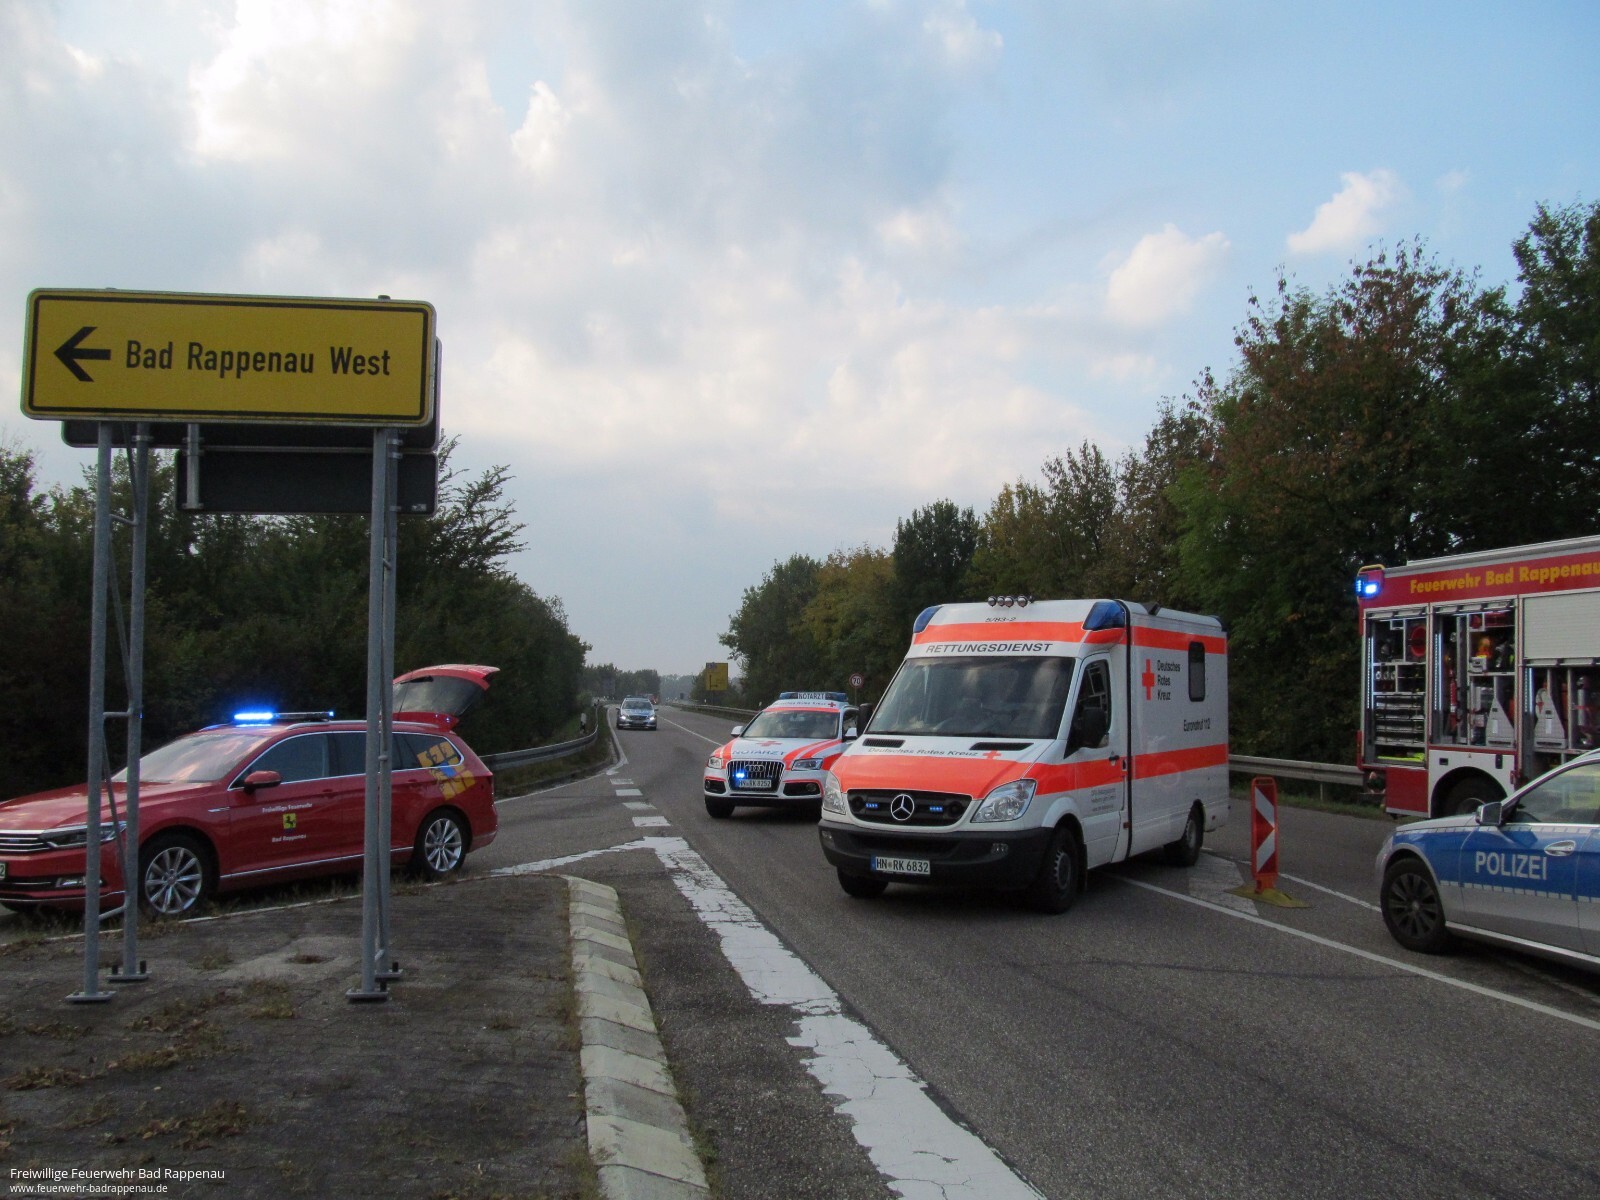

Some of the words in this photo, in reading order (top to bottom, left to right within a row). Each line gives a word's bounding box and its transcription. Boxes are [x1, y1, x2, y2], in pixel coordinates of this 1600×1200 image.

[126, 340, 173, 369] Bad
[187, 341, 315, 379] Rappenau
[330, 346, 391, 376] West
[1410, 573, 1481, 594] Feuerwehr
[1485, 568, 1513, 586] Bad
[925, 643, 1053, 653] RETTUNGSDIENST
[1157, 660, 1181, 672] Deutsches
[853, 677, 861, 685] 70
[1157, 674, 1171, 686] Rotes
[798, 692, 826, 700] NOTARZT
[1157, 689, 1171, 701] Kreuz
[876, 858, 888, 869] HN
[893, 860, 904, 871] RK
[906, 861, 929, 873] 6832
[1475, 851, 1547, 880] POLIZEI
